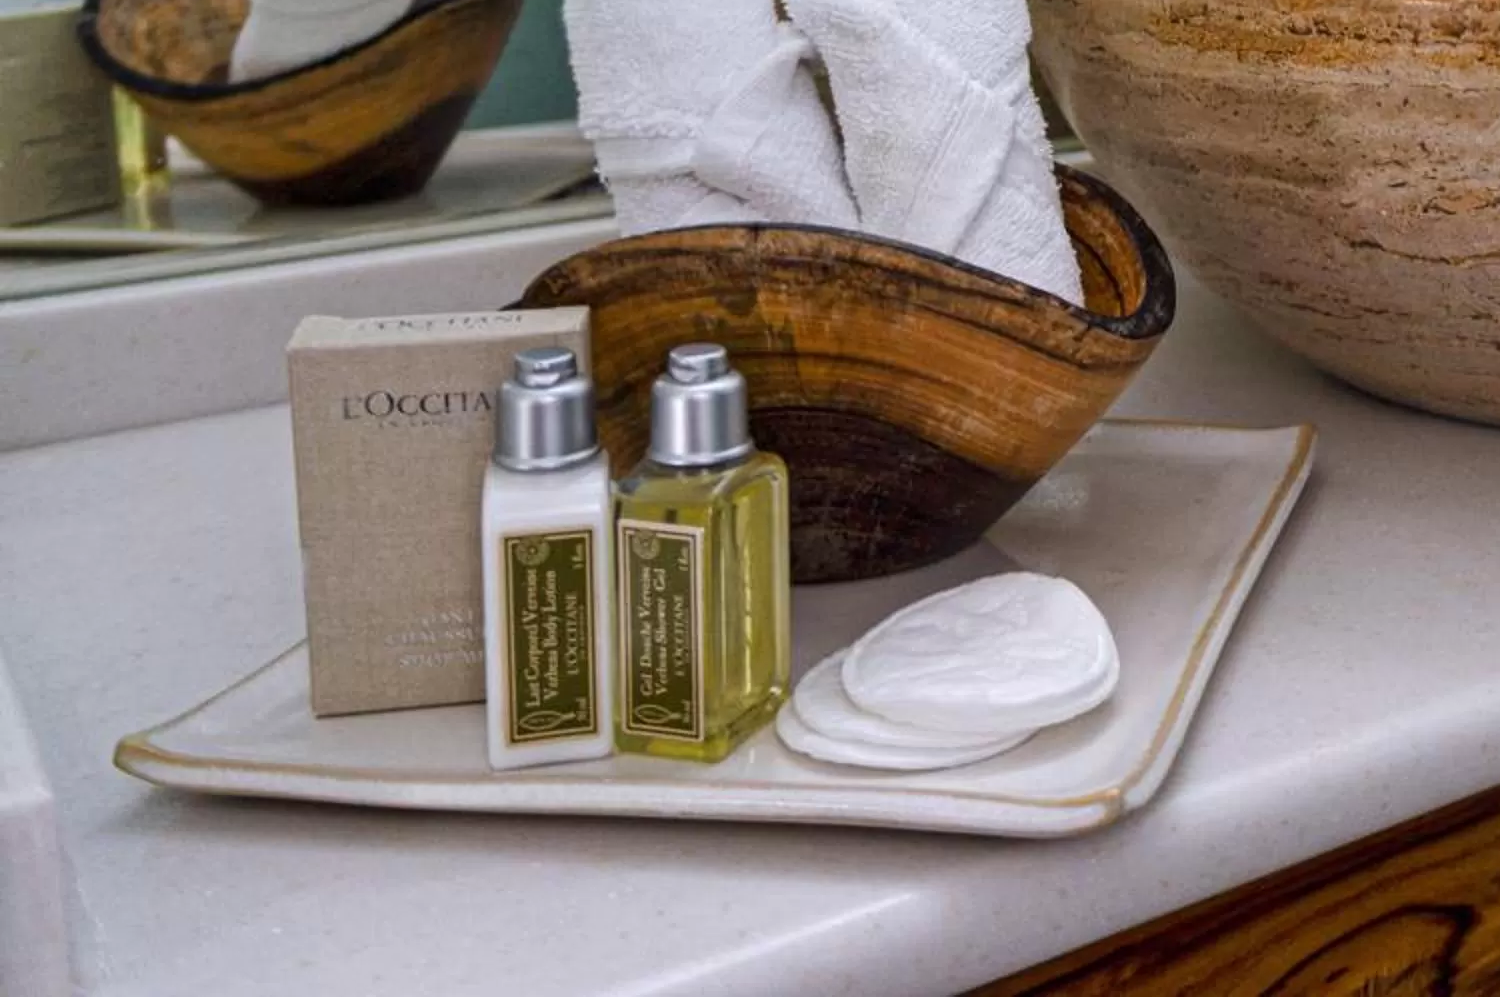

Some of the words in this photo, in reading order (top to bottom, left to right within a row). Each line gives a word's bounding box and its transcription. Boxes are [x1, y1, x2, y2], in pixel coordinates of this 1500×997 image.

[342, 390, 493, 421] L'OCCITA
[541, 570, 557, 612] Lotion
[653, 567, 667, 592] Gel
[541, 615, 560, 648] Body
[654, 597, 668, 645] Shower
[542, 650, 560, 700] Verbena
[639, 672, 653, 697] Gel
